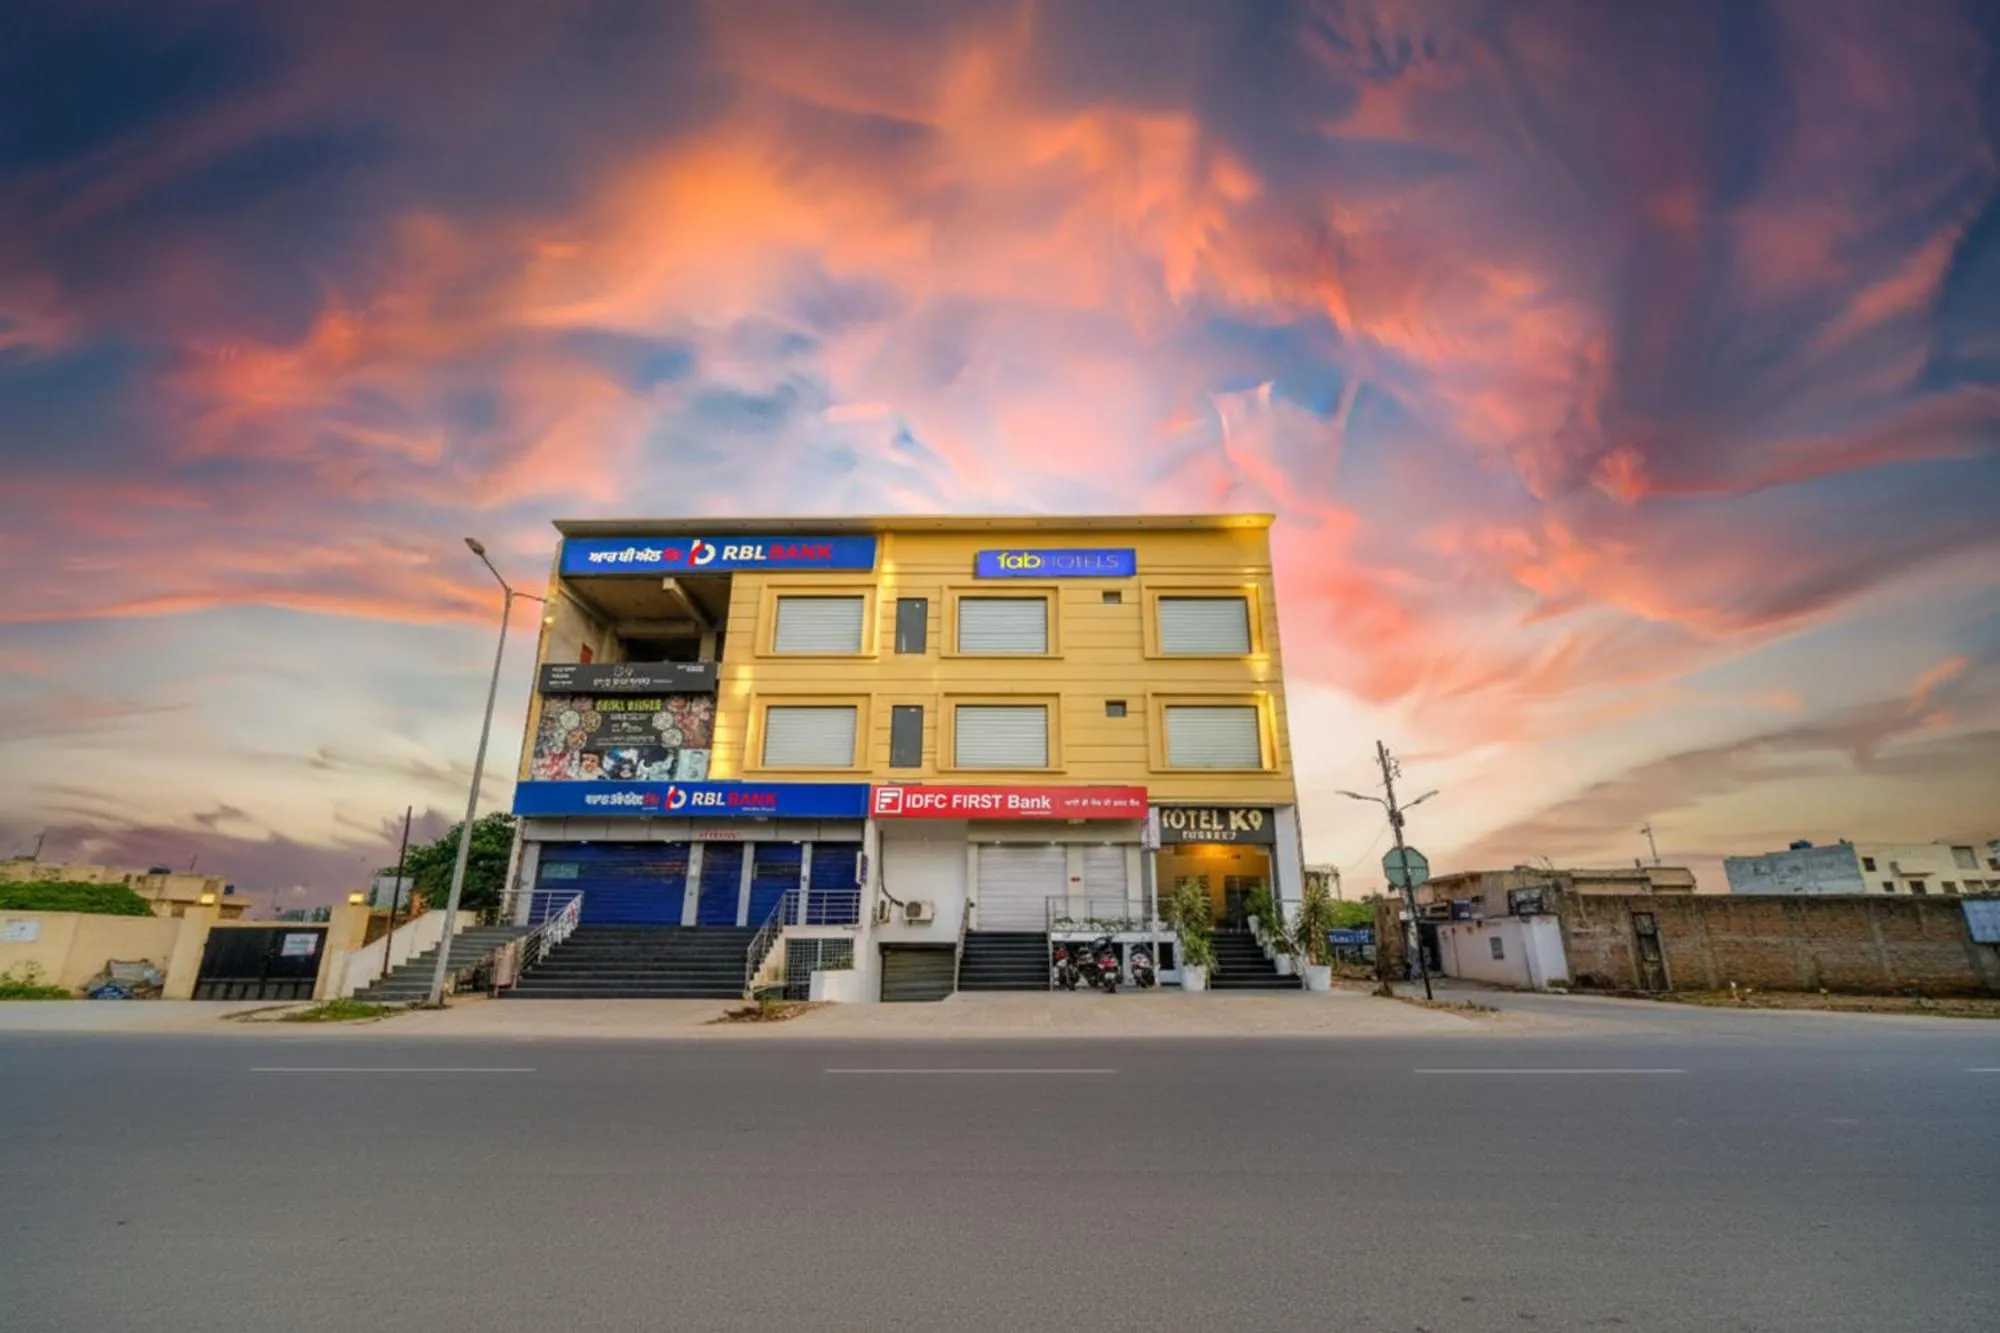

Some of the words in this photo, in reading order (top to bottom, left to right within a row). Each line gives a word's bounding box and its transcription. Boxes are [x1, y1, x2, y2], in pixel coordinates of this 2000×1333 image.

[721, 545, 767, 561] RBL
[767, 544, 833, 560] BANK
[691, 791, 725, 806] RBL
[727, 790, 777, 807] BANK
[905, 794, 948, 809] IDFC
[951, 794, 1002, 809] FIRST
[1007, 794, 1052, 809] Bank
[1228, 809, 1263, 831] K9
